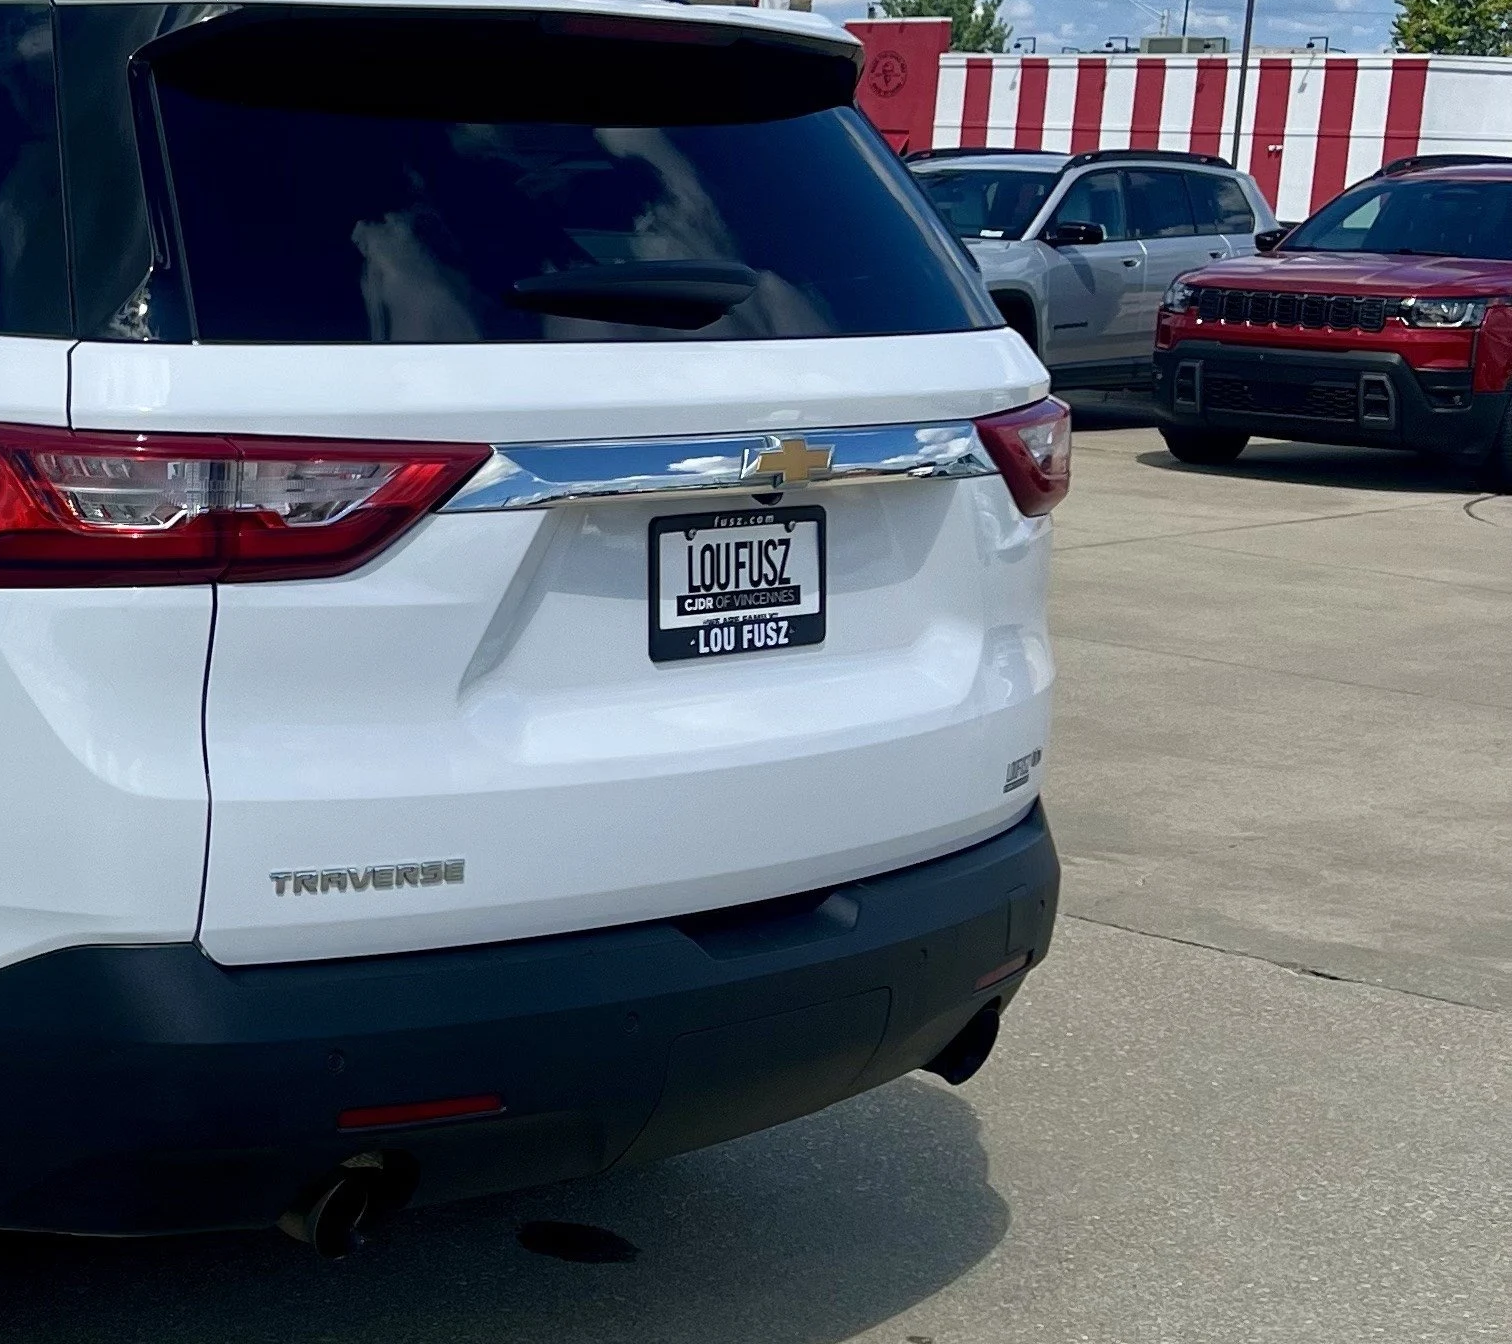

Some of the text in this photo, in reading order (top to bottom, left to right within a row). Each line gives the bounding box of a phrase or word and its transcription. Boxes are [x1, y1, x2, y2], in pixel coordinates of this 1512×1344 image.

[714, 514, 775, 527] fusz.com
[687, 538, 791, 593] LOU FUSZ
[684, 590, 795, 612] CJDR OF VINCENNES
[699, 621, 789, 653] LOU FUSZ
[269, 858, 465, 897] TRAVERSE
